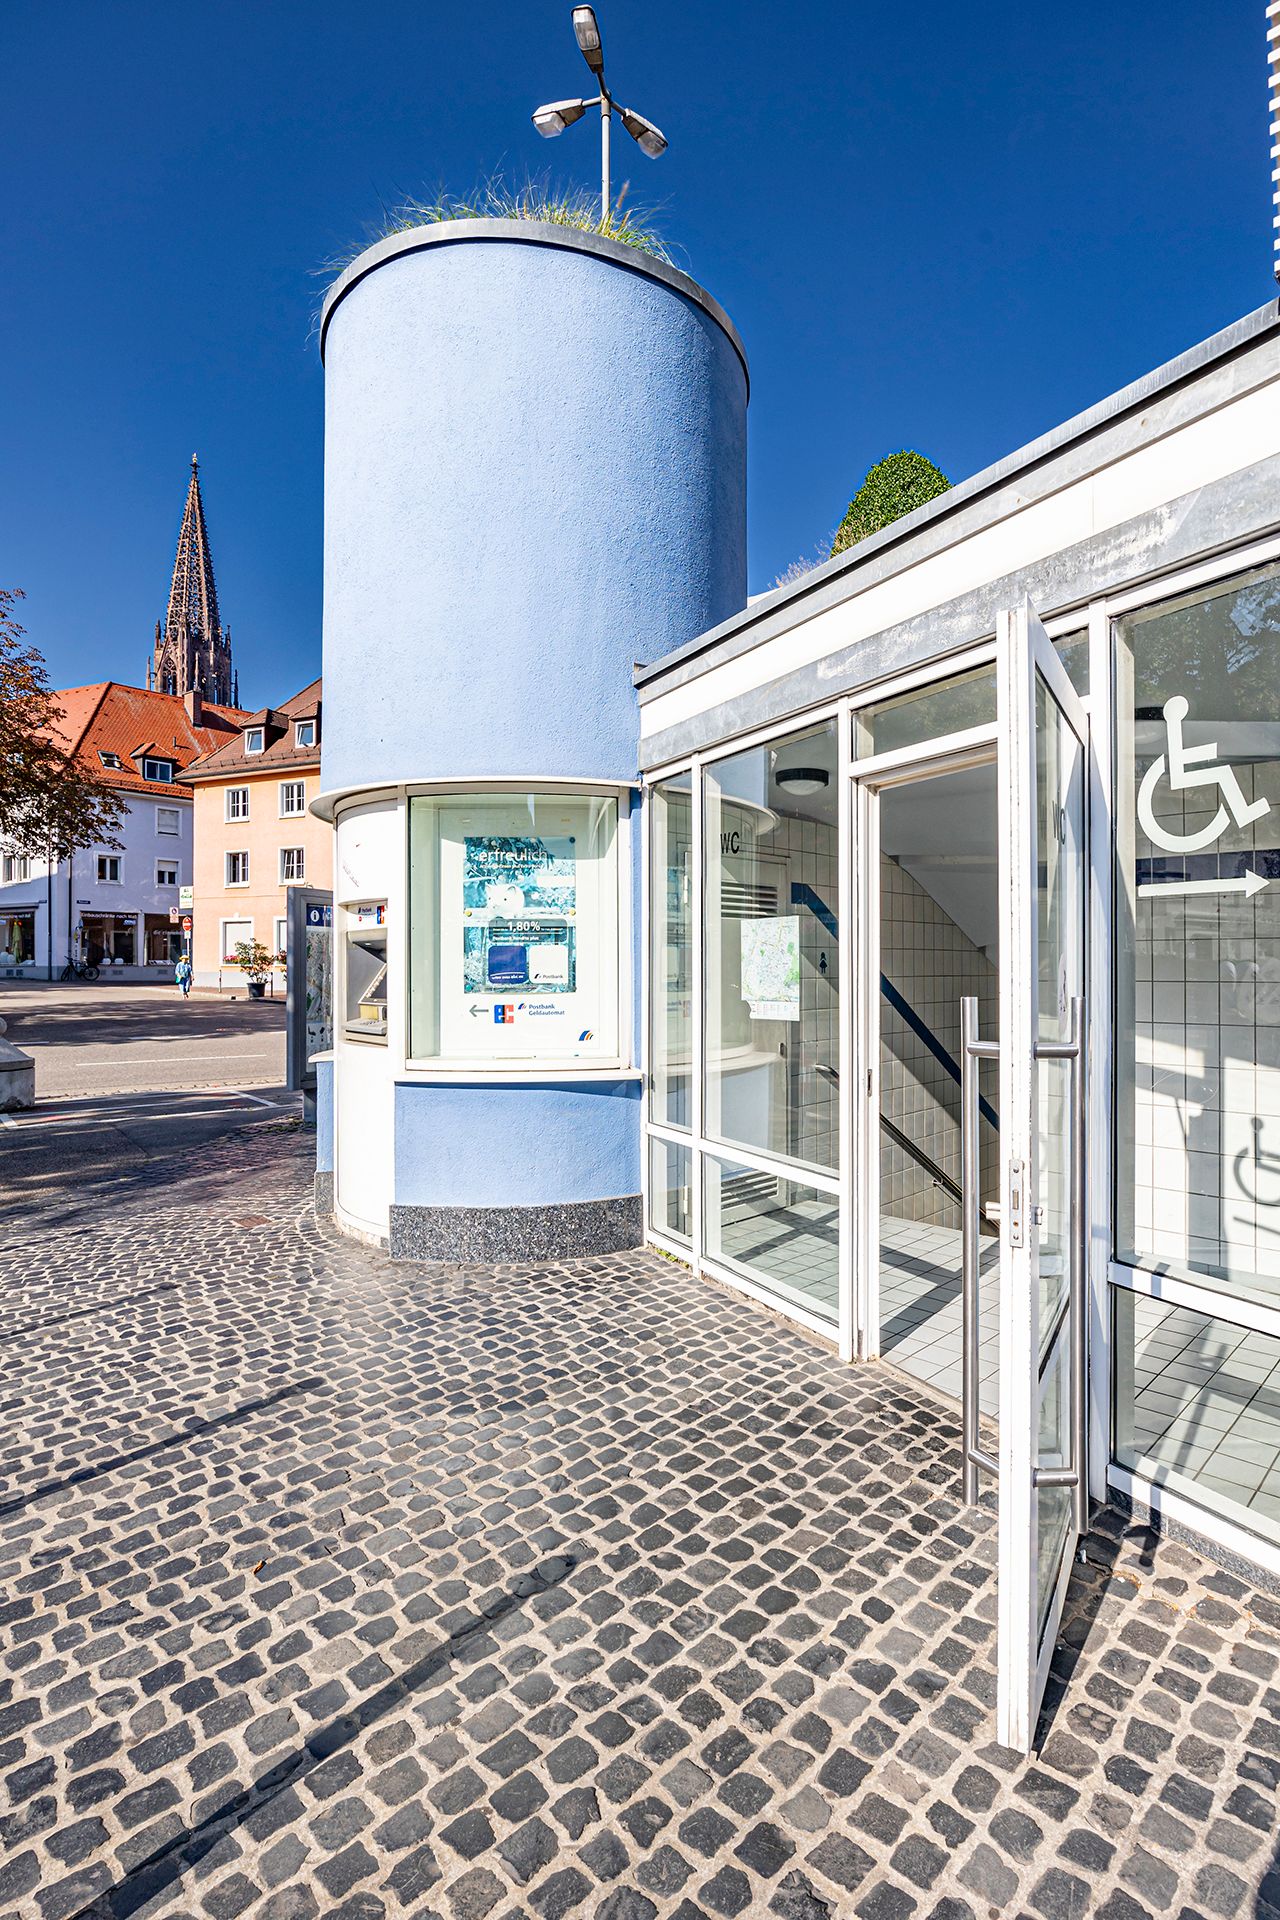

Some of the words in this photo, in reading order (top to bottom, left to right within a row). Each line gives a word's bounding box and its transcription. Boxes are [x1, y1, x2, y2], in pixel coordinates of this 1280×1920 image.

[720, 831, 740, 854] WC
[479, 848, 547, 862] erfreulich
[507, 921, 541, 933] 1,80%
[494, 1004, 514, 1024] ec
